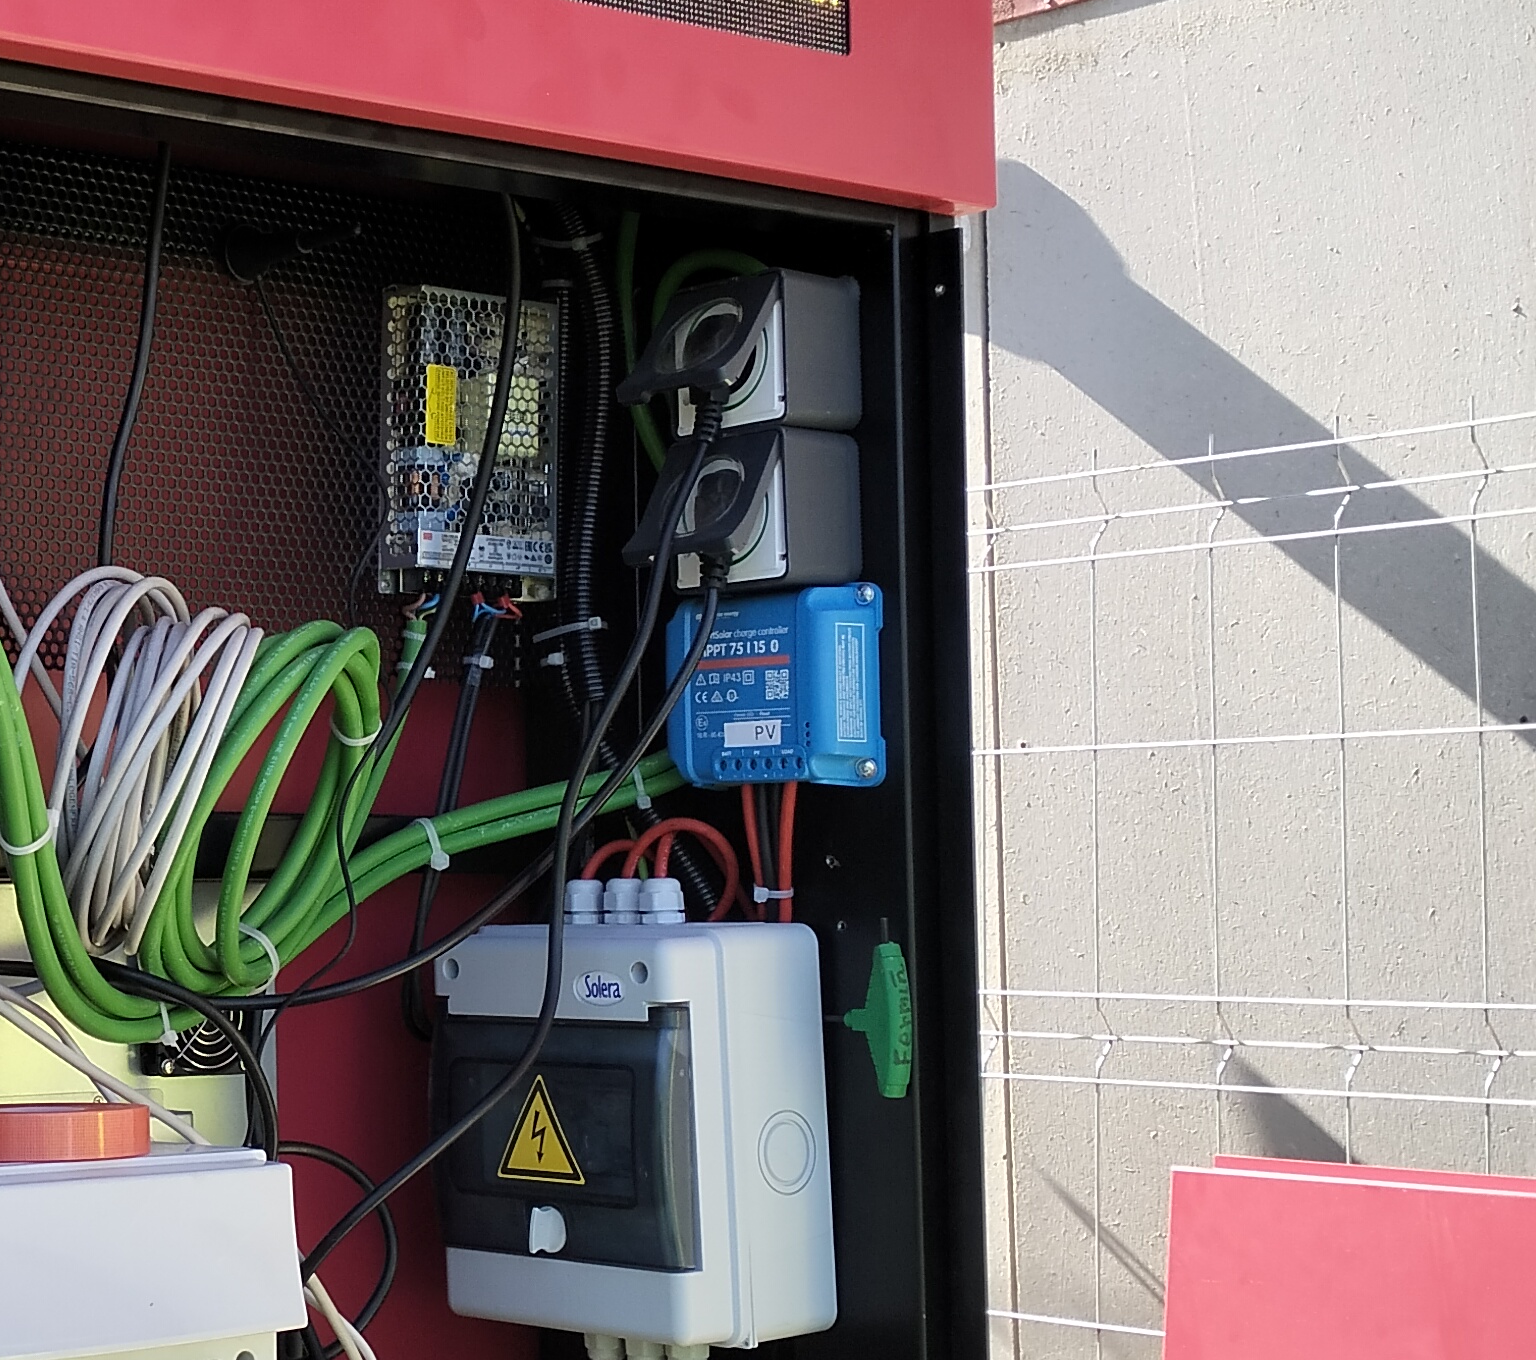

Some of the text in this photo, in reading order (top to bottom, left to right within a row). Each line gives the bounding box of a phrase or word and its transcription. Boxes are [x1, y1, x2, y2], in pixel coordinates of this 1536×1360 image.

[734, 628, 756, 638] charge
[757, 626, 789, 636] controller
[729, 642, 743, 655] 75
[754, 641, 765, 653] 15
[723, 673, 741, 683] IP43
[754, 725, 776, 740] PV
[585, 975, 622, 1000] Solera
